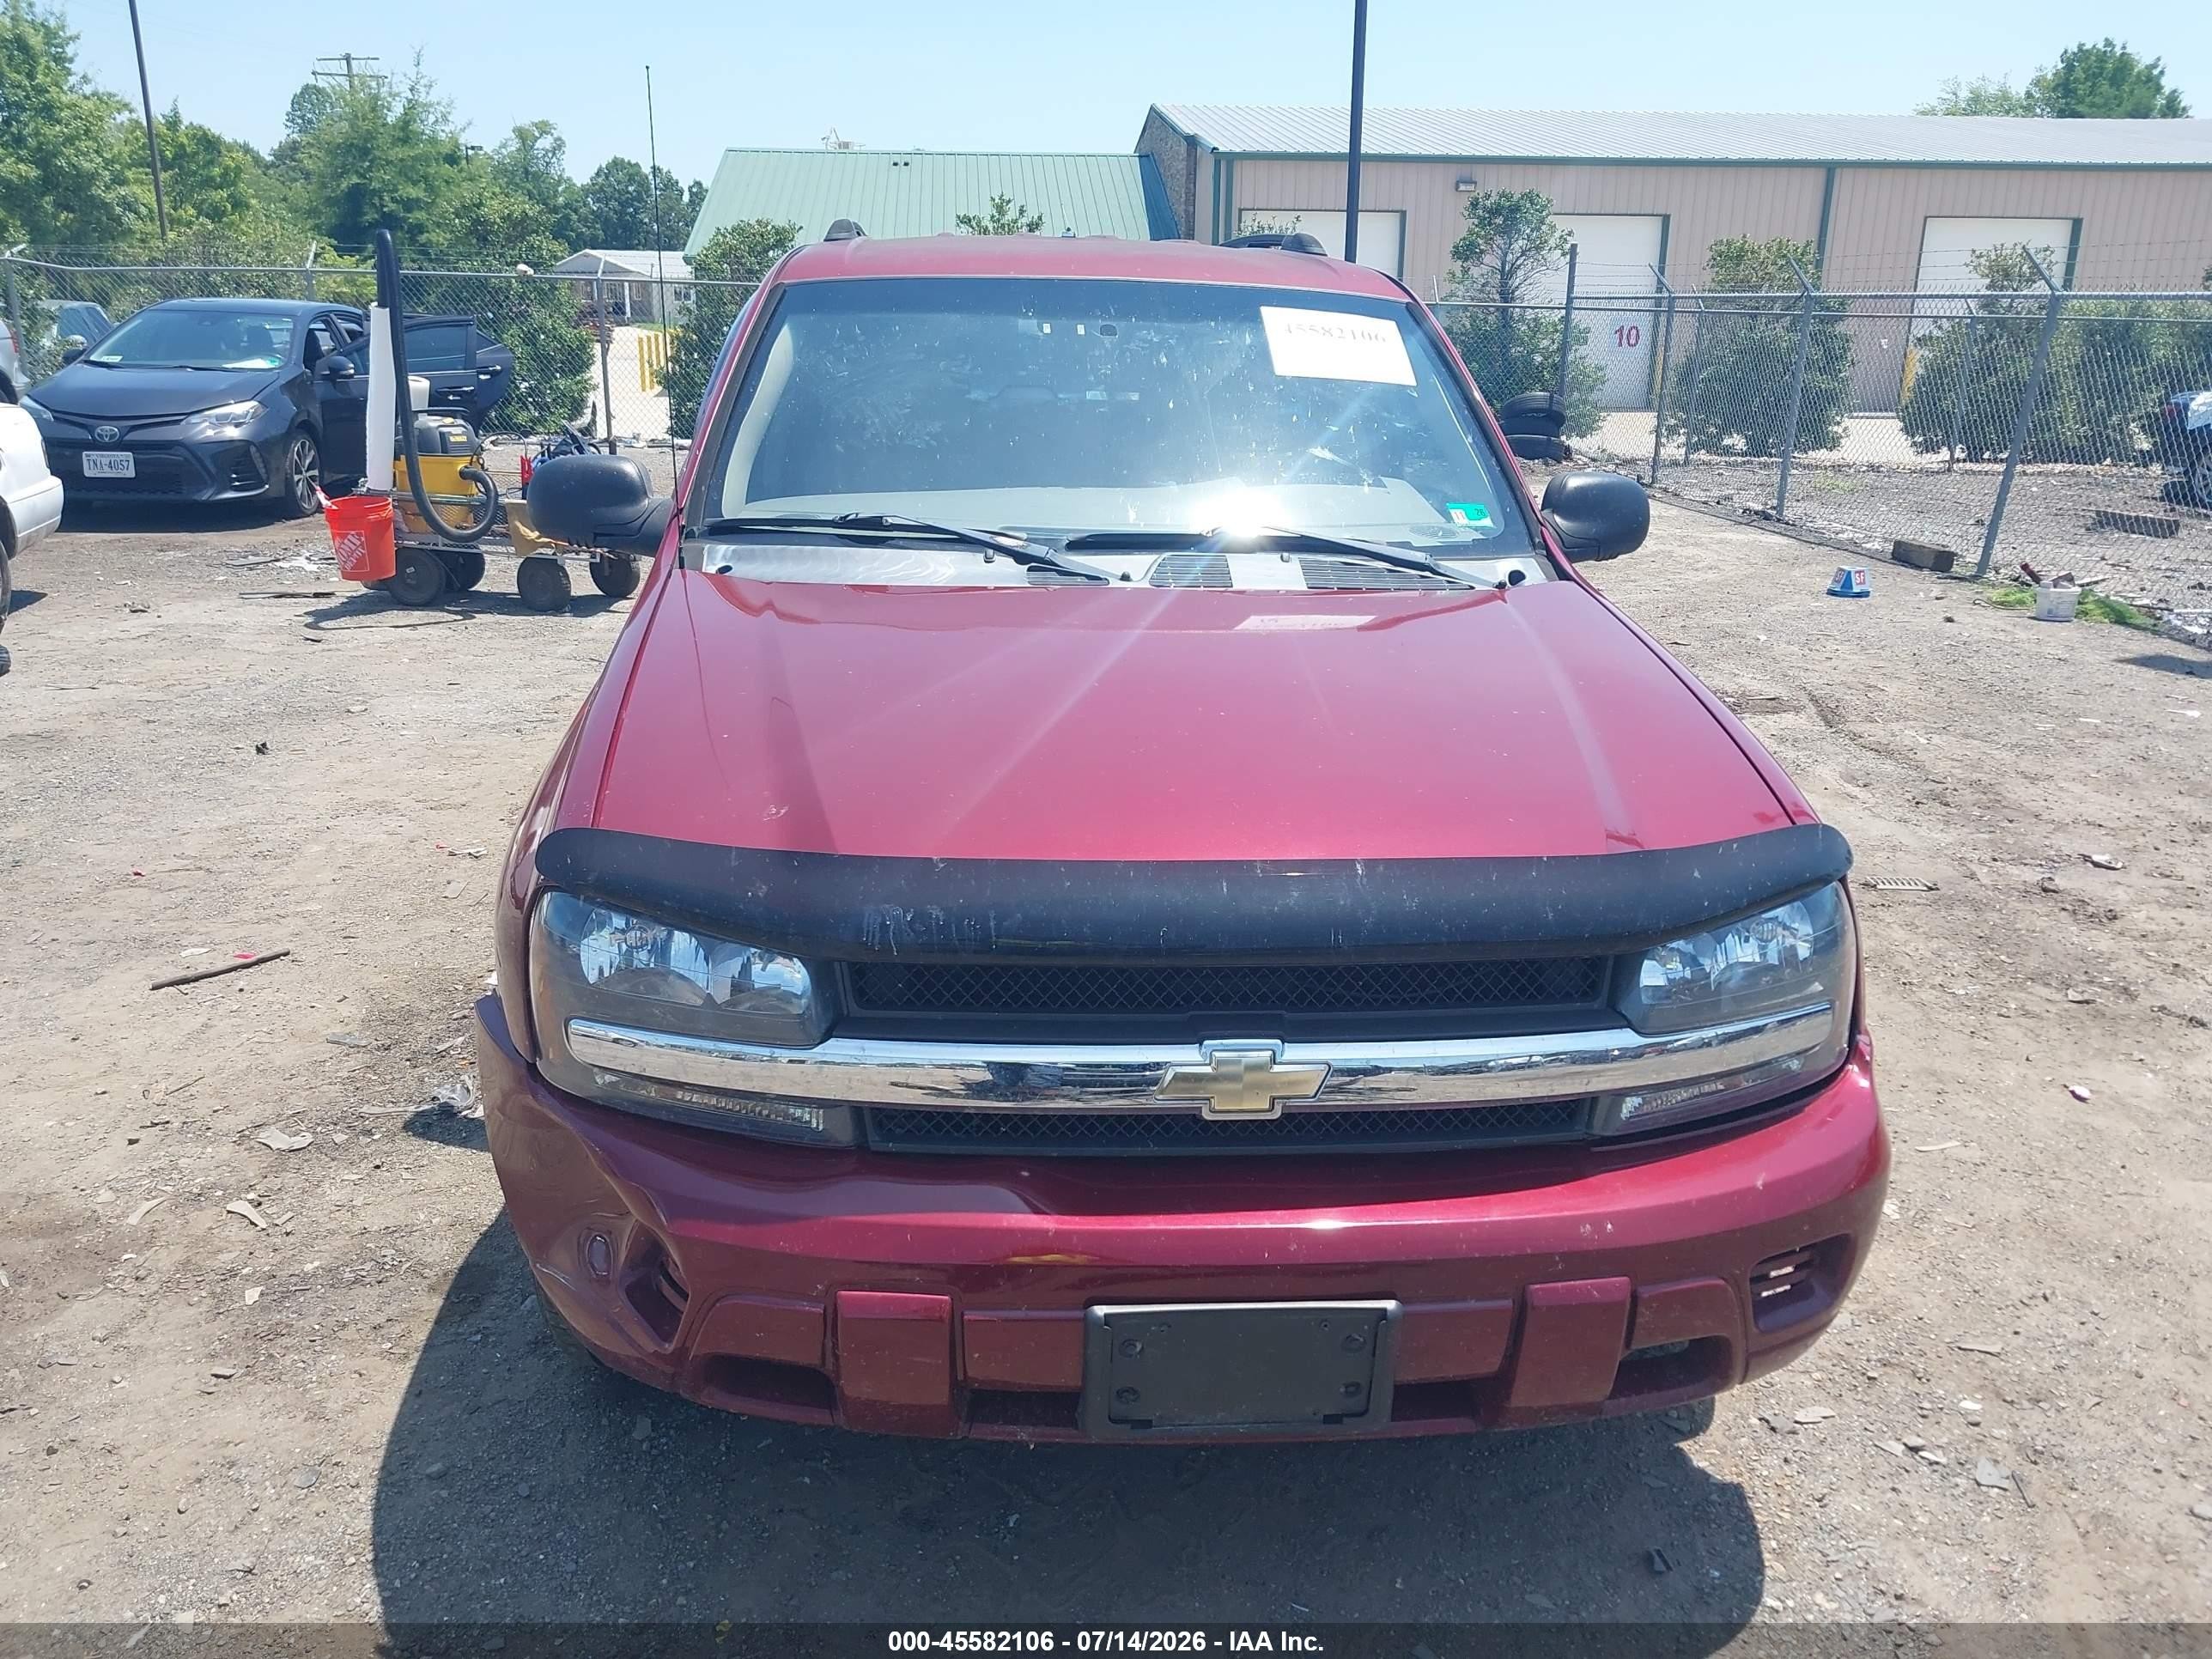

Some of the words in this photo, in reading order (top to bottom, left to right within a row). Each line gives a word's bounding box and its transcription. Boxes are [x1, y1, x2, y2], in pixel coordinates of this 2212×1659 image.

[1614, 325, 1640, 348] 10
[87, 459, 130, 471] TNA-4057
[1855, 572, 1864, 584] SF
